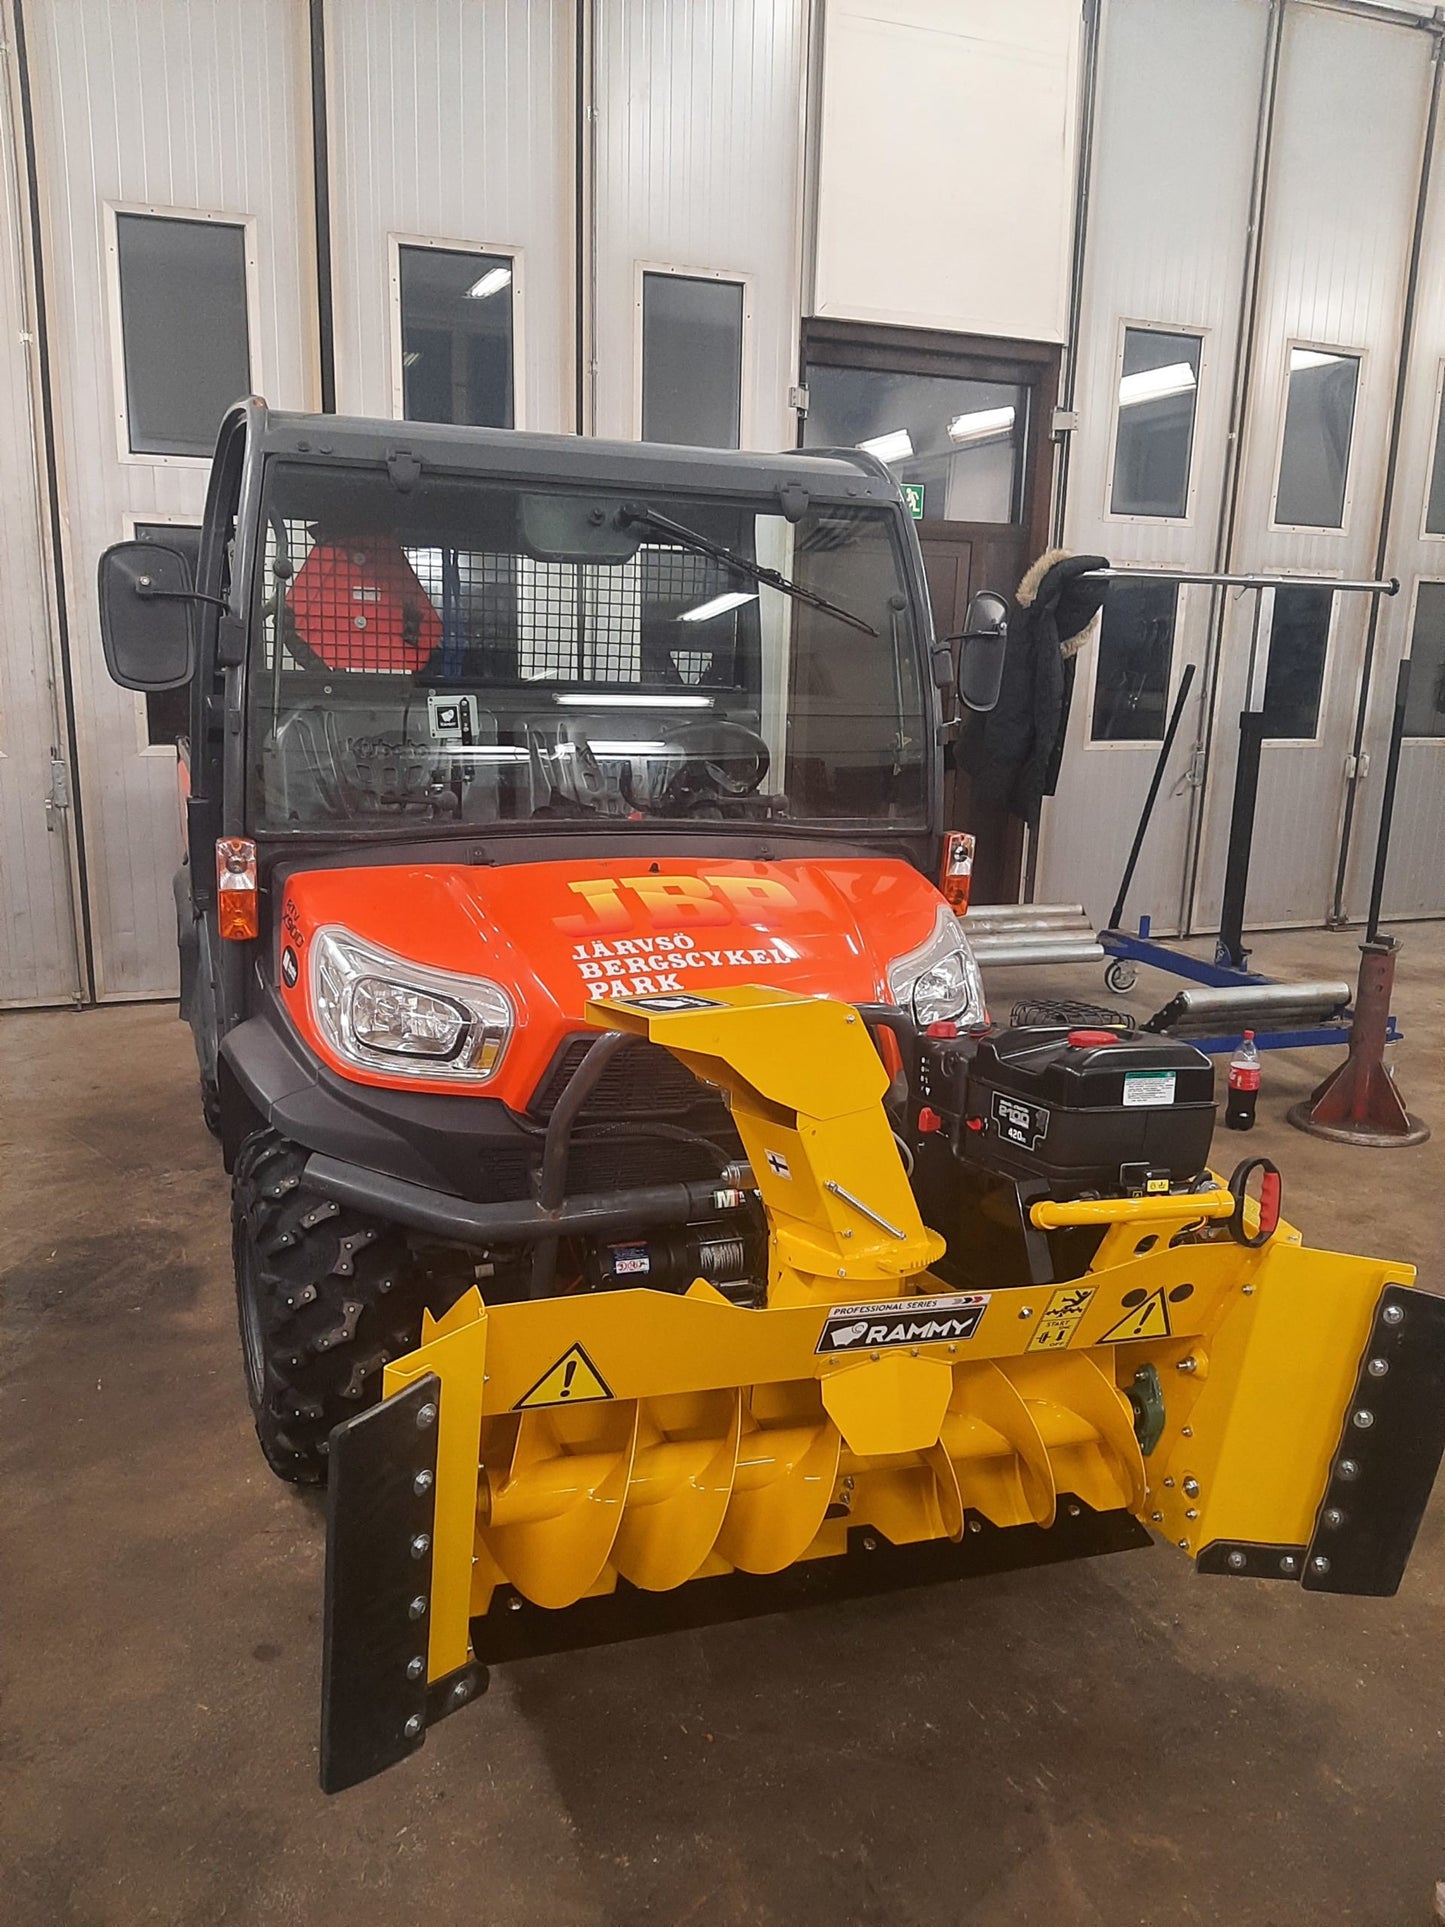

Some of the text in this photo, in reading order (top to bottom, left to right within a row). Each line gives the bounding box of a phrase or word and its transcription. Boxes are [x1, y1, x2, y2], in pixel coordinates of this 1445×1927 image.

[552, 876, 798, 937] JBP
[572, 933, 694, 960] JÄRVSÖ
[577, 948, 794, 979] BERGSCYKEL
[587, 973, 684, 1000] PARK
[833, 1300, 937, 1316] PROFESSIONAL SERIES
[865, 1317, 974, 1344] RAMMY
[1047, 1320, 1070, 1328] START
